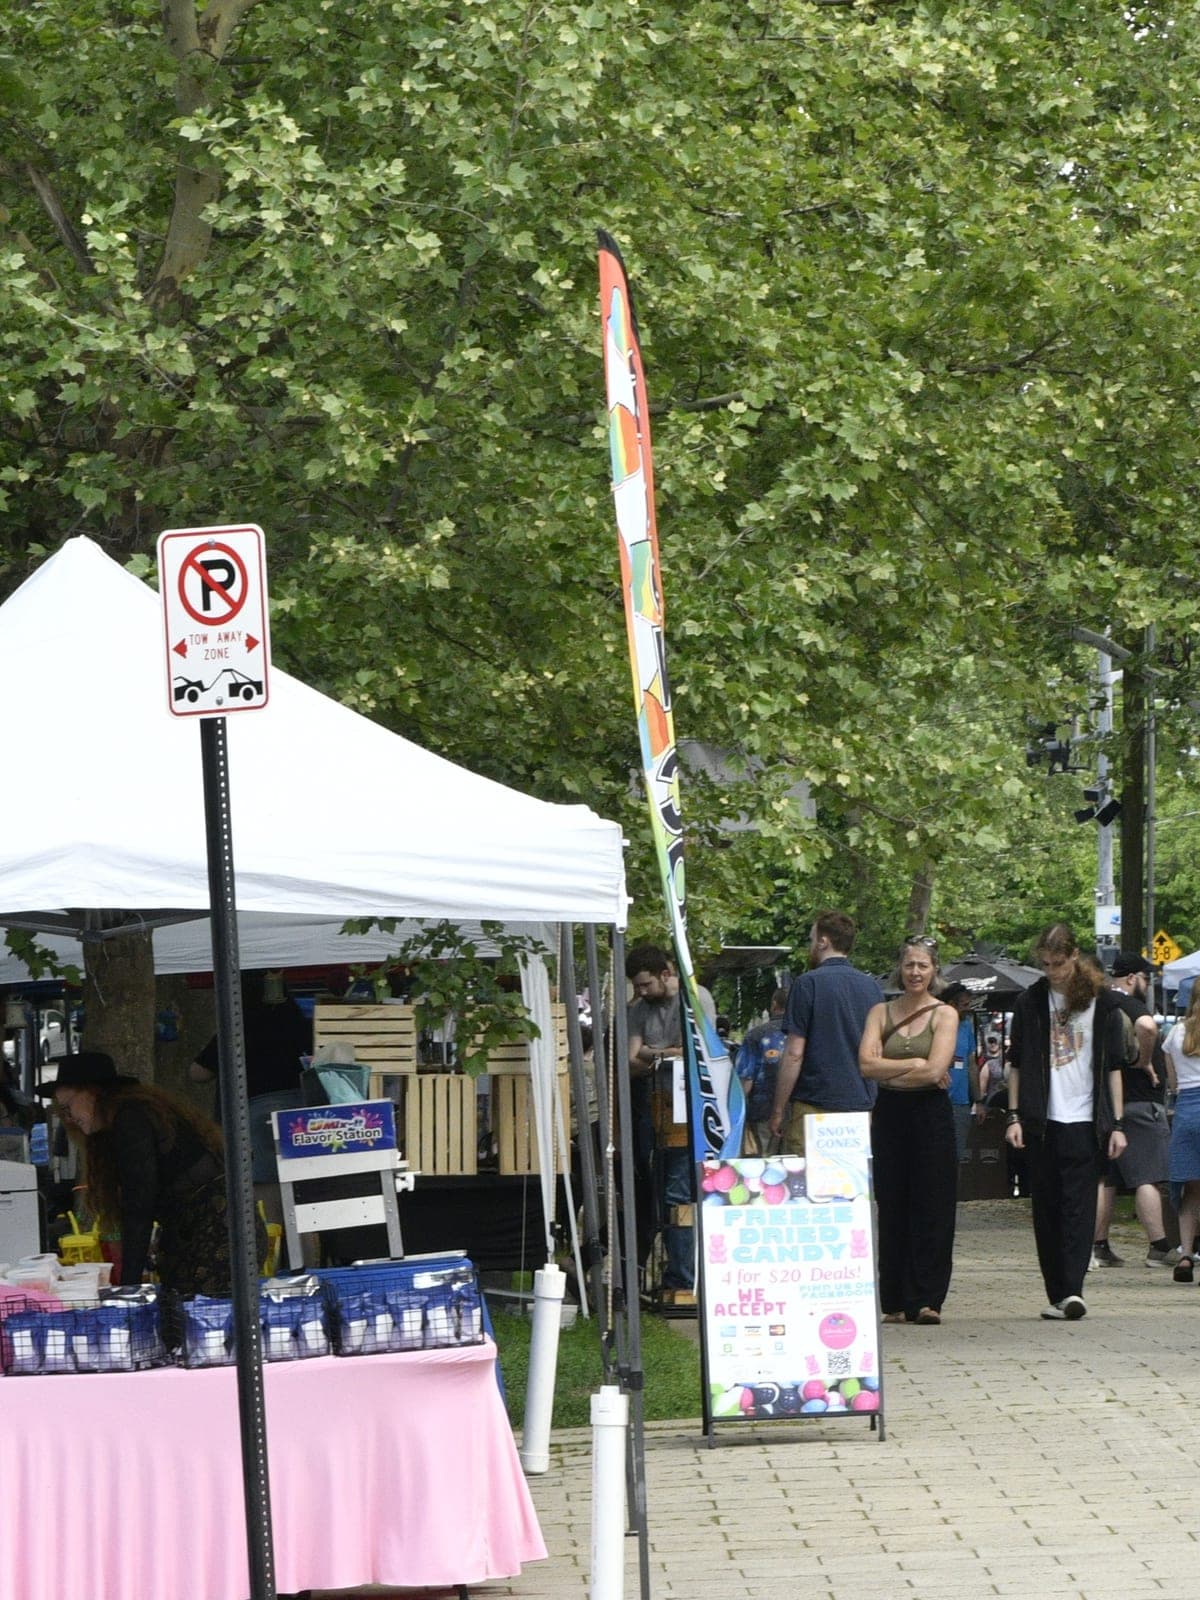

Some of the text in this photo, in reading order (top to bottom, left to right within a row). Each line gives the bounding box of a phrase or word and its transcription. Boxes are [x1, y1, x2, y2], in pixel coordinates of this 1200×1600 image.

[189, 630, 242, 645] TOW AWAY
[203, 647, 230, 660] ZONE
[293, 1128, 381, 1145] Flavor Station
[816, 1126, 858, 1137] SNOW
[816, 1137, 862, 1149] CONES
[724, 1206, 854, 1226] FREEZE
[738, 1225, 841, 1245] DRIED
[732, 1243, 848, 1264] CANDY
[722, 1265, 862, 1286] 4 for $20 Deals!
[738, 1287, 766, 1302] WE
[714, 1302, 787, 1317] ACCEPT
